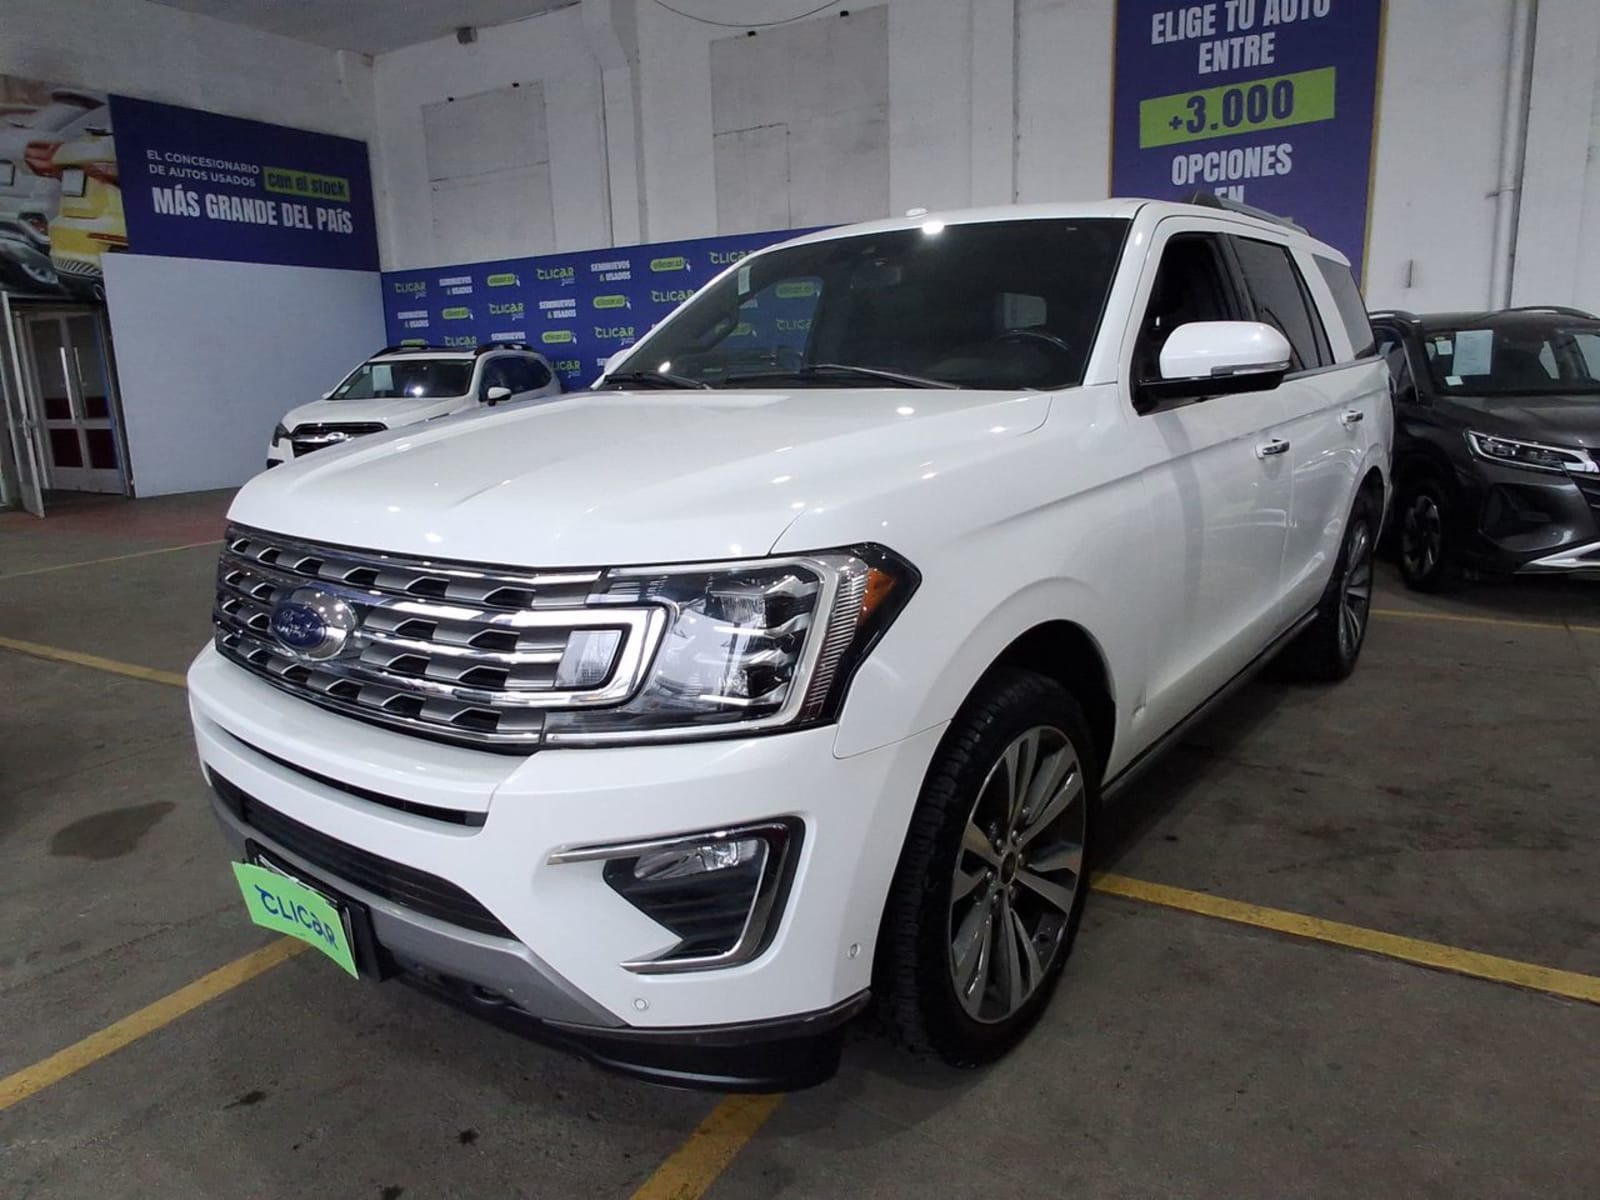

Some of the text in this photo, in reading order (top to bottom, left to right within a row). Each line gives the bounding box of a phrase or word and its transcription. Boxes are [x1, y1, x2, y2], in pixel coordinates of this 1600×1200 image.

[1151, 0, 1331, 45] ELIGE TU AUTO
[1198, 32, 1275, 74] ENTRE
[1168, 79, 1295, 134] +3.000
[147, 150, 260, 175] EL CONCESIONARIO
[149, 164, 256, 187] DE AUTOS USADOS
[1171, 143, 1293, 185] OPCIONES
[152, 184, 354, 234] MÁS GRANDE DEL PAÍS
